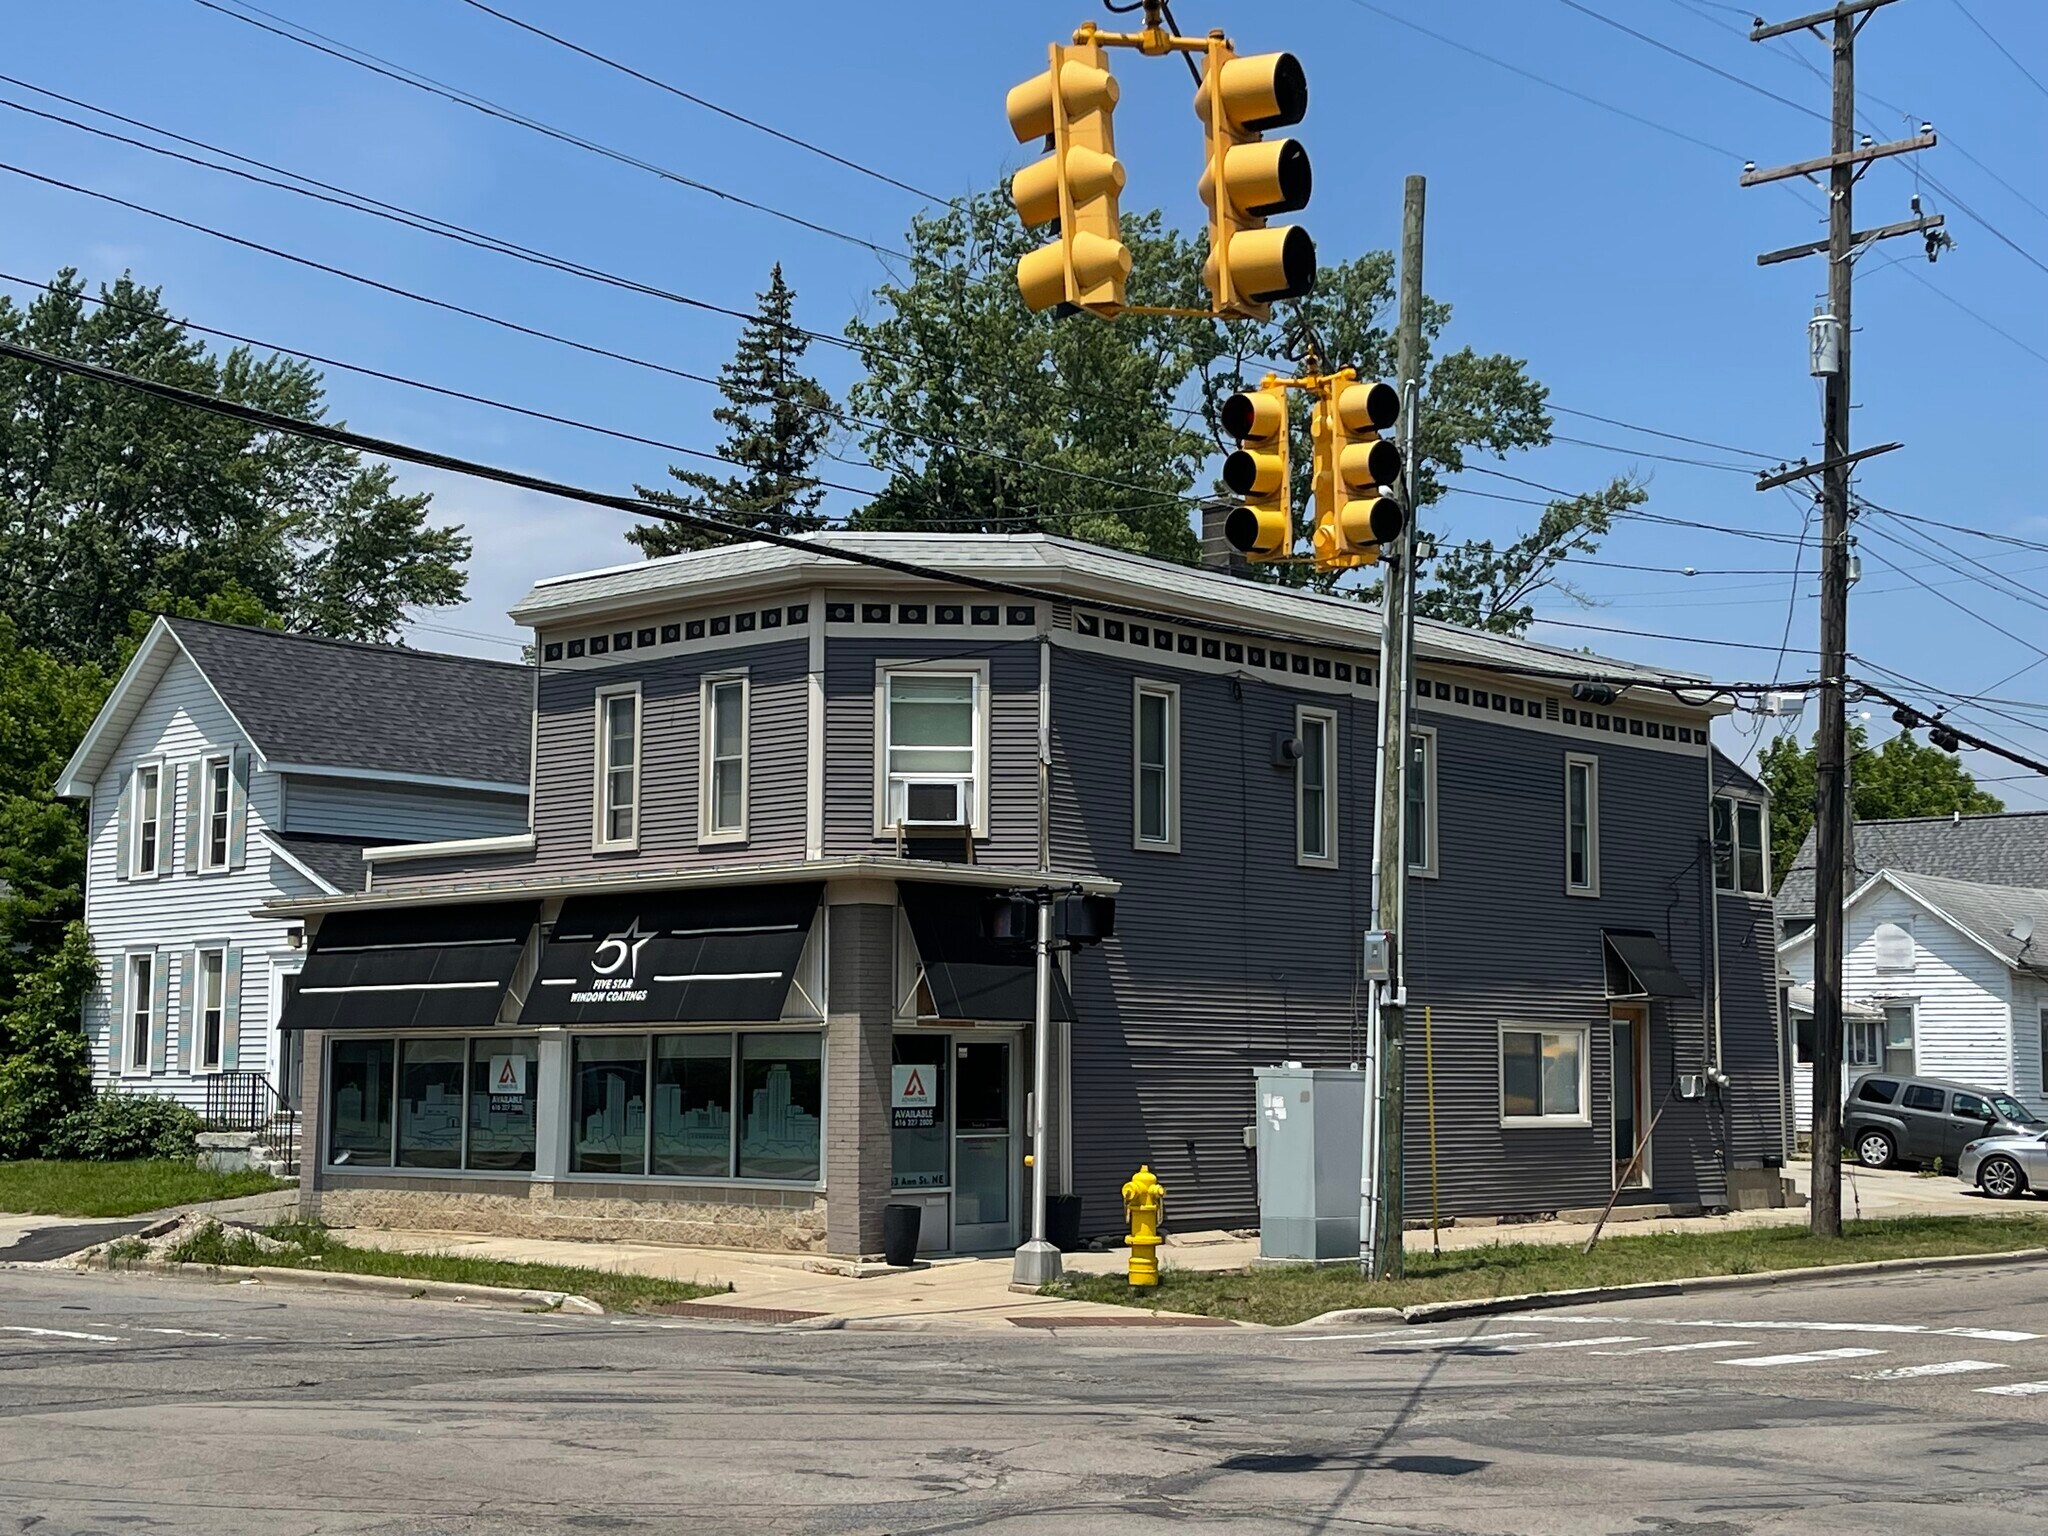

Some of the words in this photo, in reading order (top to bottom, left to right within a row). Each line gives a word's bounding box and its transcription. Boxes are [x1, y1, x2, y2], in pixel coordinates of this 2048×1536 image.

[593, 978, 612, 990] FIVE
[612, 978, 634, 989] STAR
[570, 991, 606, 1002] WINDOW
[606, 990, 648, 1002] COATINGS
[894, 1109, 934, 1119] AVAILABLE
[932, 1174, 944, 1184] NE
